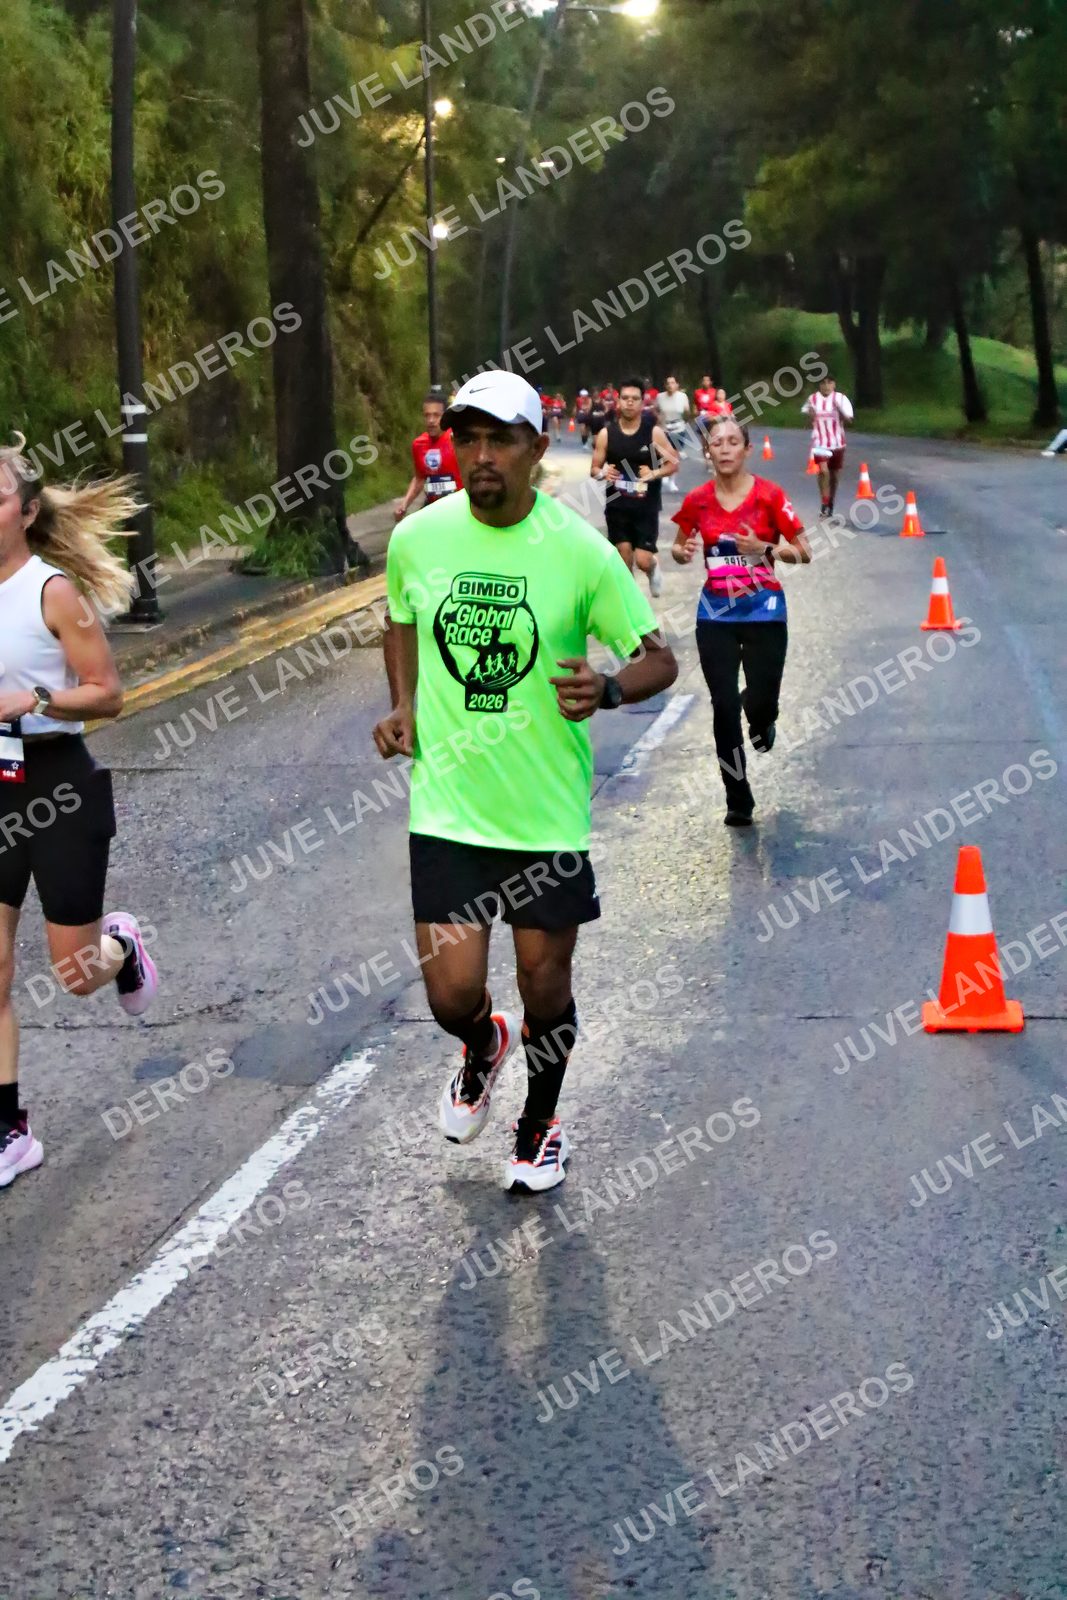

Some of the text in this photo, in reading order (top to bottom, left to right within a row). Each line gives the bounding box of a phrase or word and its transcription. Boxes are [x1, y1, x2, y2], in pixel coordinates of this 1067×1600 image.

[458, 581, 519, 598] BIMBO
[456, 604, 516, 628] Global
[445, 622, 493, 646] Race
[468, 693, 504, 709] 2026
